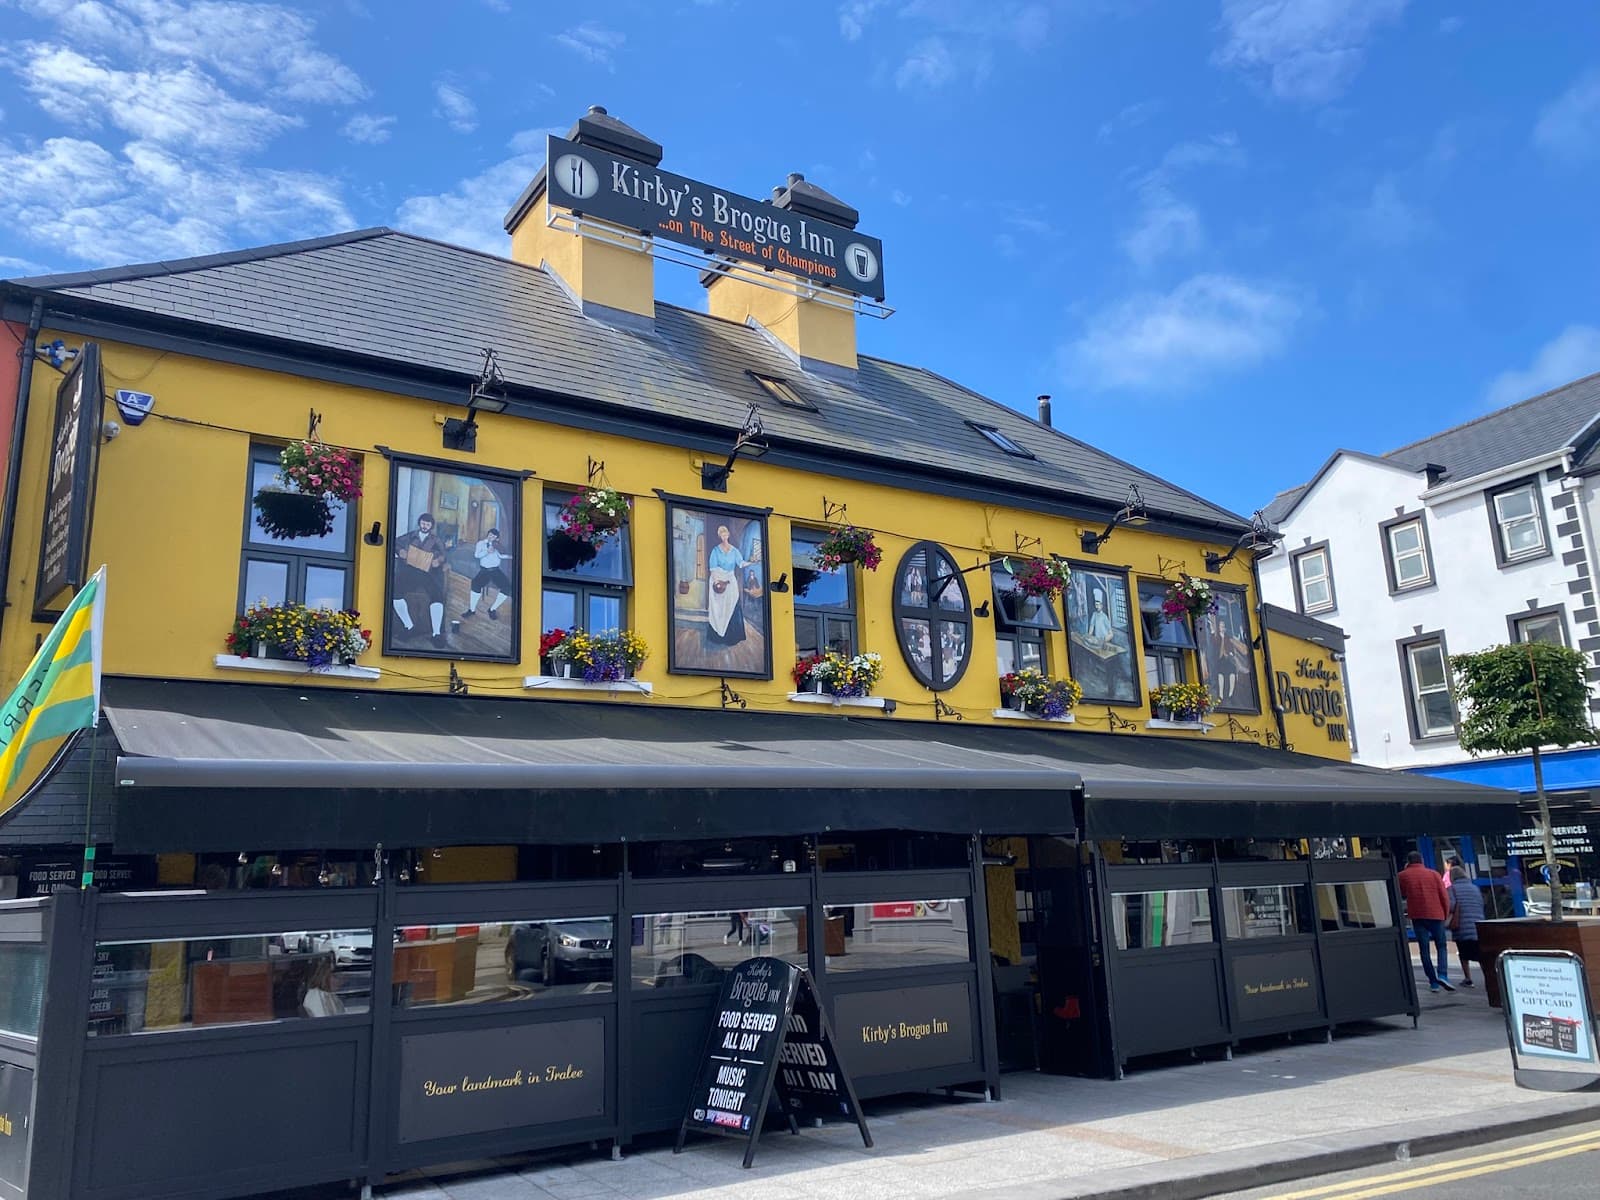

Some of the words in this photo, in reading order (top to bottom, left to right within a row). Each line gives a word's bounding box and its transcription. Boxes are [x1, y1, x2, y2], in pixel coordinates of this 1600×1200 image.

[611, 160, 703, 217] Kirby's
[712, 192, 791, 244] Brogue
[799, 220, 836, 258] Inn
[689, 220, 715, 243] The
[719, 229, 757, 256] Street
[761, 244, 774, 260] of
[777, 247, 837, 279] Champions
[1276, 671, 1342, 727] Brogue
[1326, 723, 1347, 743] INN
[1552, 825, 1588, 836] SERVICES
[1580, 845, 1594, 853] FAX
[29, 870, 48, 881] FOOD
[49, 869, 77, 881] SERVED
[747, 959, 772, 978] Kirby's
[729, 972, 769, 1008] Brogue
[1545, 998, 1573, 1008] CARD
[718, 1010, 742, 1029] FOOD
[741, 1012, 777, 1032] SERVED
[861, 1023, 897, 1044] Kirby's
[899, 1022, 931, 1040] Brogue
[933, 1018, 949, 1034] Inn
[722, 1031, 738, 1050] ALL
[739, 1032, 761, 1052] DAY
[424, 1080, 457, 1096] Your
[462, 1069, 523, 1093] landmark
[527, 1072, 541, 1084] in
[545, 1063, 584, 1082] Tralee
[716, 1064, 747, 1087] MUSIC
[707, 1087, 746, 1111] TONIGHT
